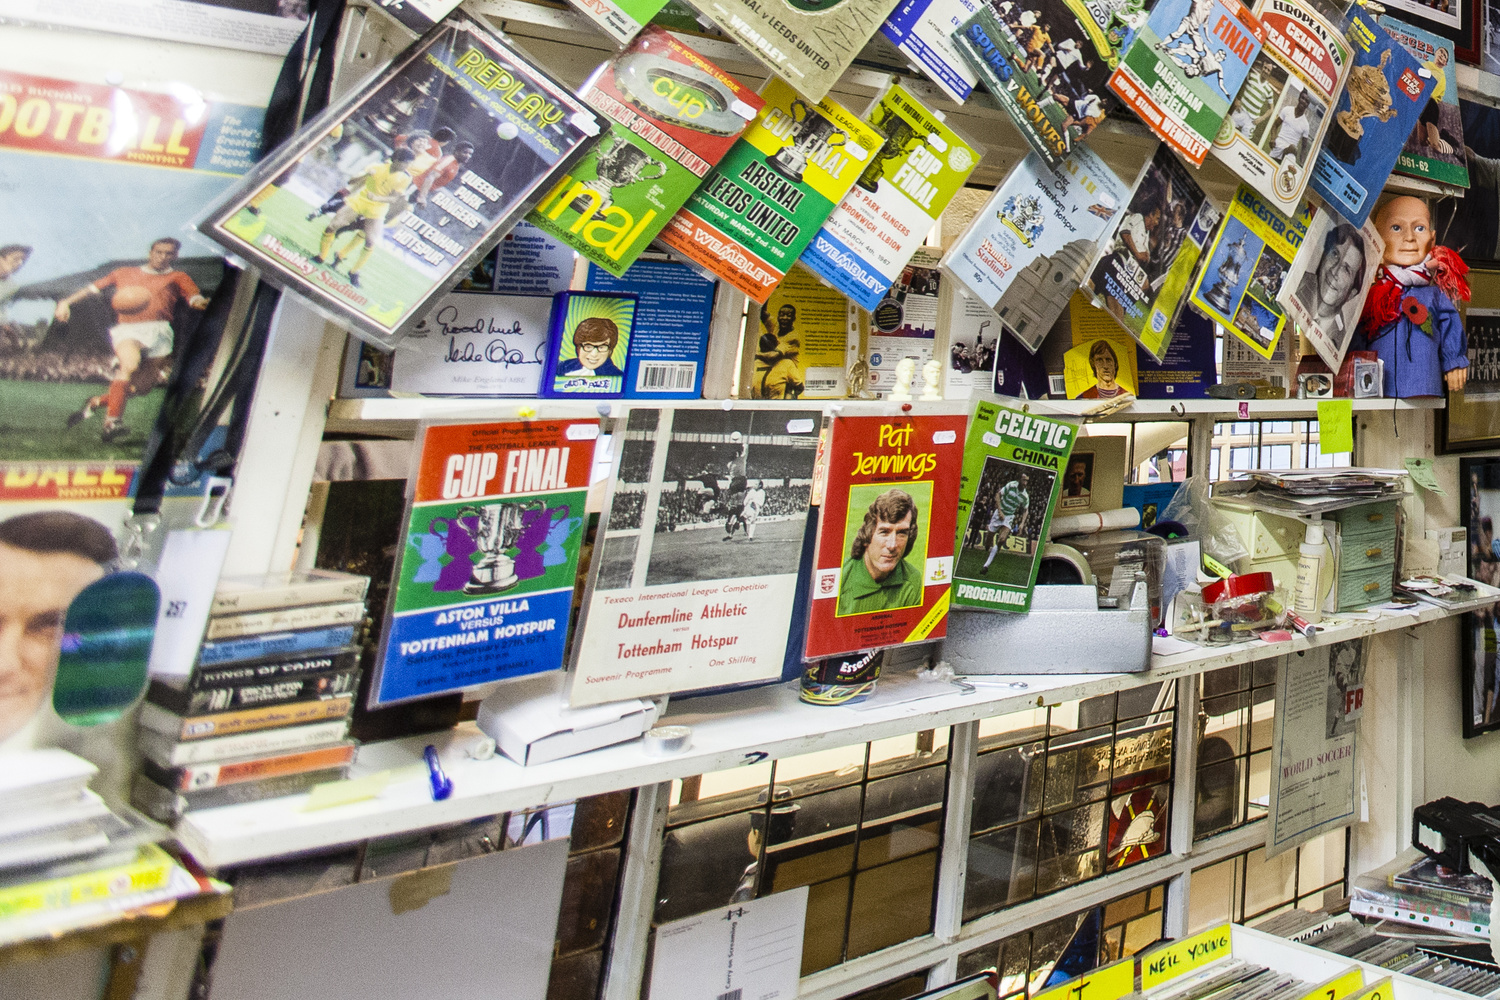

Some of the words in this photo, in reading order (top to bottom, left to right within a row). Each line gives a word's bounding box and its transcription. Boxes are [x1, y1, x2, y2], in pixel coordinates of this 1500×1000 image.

[729, 14, 788, 63] WEMBLEY
[1212, 14, 1256, 66] FINAL
[1273, 0, 1329, 42] EUROPEAN
[1328, 36, 1343, 68] CUP
[1285, 21, 1326, 62] CELTIC
[453, 46, 565, 129] REPLAY
[966, 22, 1014, 82] SPURS
[1015, 85, 1067, 157] WOLVES
[1153, 60, 1205, 114] DAGENHAM
[1291, 50, 1333, 93] MADRID
[651, 76, 706, 120] cup
[1114, 76, 1138, 100] EMPIRE
[1135, 95, 1163, 126] STADIUM
[1160, 116, 1207, 159] WEMBLEY
[1151, 82, 1190, 121] ENFIELD
[761, 107, 802, 142] CUP
[801, 133, 849, 181] FINAL
[908, 144, 944, 178] CUP
[453, 187, 483, 211] PARK
[459, 170, 503, 203] QUEENS
[740, 159, 805, 214] ARSENAL
[892, 162, 940, 210] FINAL
[431, 191, 482, 229] RANGERS
[703, 172, 754, 221] LEEDS
[747, 201, 800, 248] UNITED
[840, 200, 879, 235] BROMWICH
[876, 228, 902, 253] ALBION
[862, 194, 882, 215] PARK
[881, 210, 911, 237] RANGERS
[391, 228, 445, 267] HOTSPUR
[399, 209, 465, 258] TOTTENHAM
[262, 233, 318, 278] Wembley
[316, 266, 369, 307] Stadium
[694, 226, 779, 288] WEMBLEY
[815, 235, 887, 295] WEMBLEY
[1111, 258, 1150, 304] NEWCASTLE
[878, 422, 914, 449] Pat
[993, 409, 1072, 451] CELTIC
[442, 450, 500, 500] CUP
[503, 446, 571, 494] FINAL
[851, 447, 937, 479] Jennings
[1011, 448, 1059, 470] CHINA
[435, 606, 486, 627] ASTON
[489, 599, 530, 620] VILLA
[617, 609, 694, 630] Dunfermline
[699, 603, 748, 621] Athletic
[956, 584, 1028, 606] PROGRAMME
[400, 628, 489, 657] TOTTENHAM
[494, 618, 557, 641] HOTSPUR
[459, 615, 504, 632] VERSUS
[615, 639, 682, 661] Tottenham
[689, 633, 740, 651] Hotspur
[584, 672, 622, 686] Souvenir
[624, 666, 673, 682] Programme
[708, 658, 725, 668] One
[727, 654, 758, 667] Shilling
[1282, 756, 1314, 779] WORLD
[1315, 744, 1352, 767] SOCCER
[1147, 951, 1182, 979] NEIL
[1182, 932, 1229, 966] YOUNG
